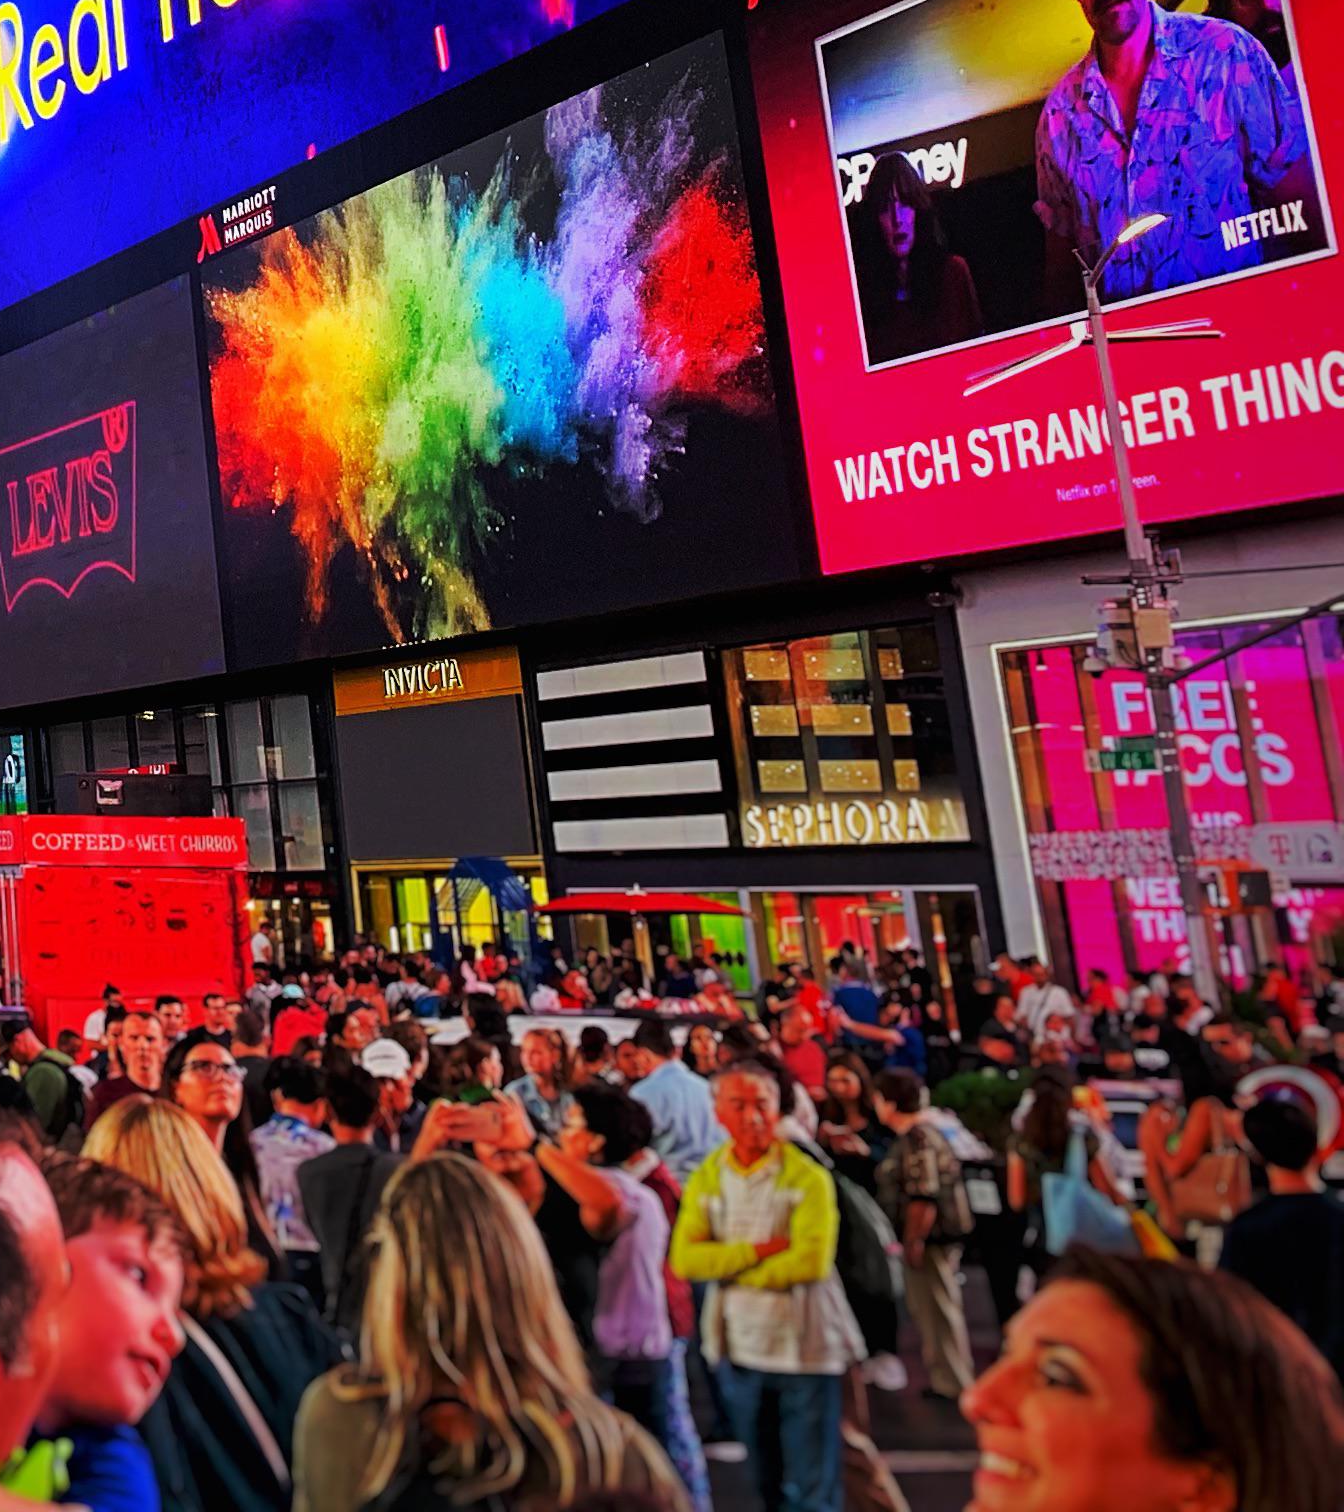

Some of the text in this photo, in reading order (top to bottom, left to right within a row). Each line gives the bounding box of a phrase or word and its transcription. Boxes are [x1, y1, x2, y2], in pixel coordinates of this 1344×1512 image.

[222, 186, 276, 224] MARRIOTT
[224, 210, 272, 244] MARQUIS
[1220, 199, 1308, 252] NETFLIX
[834, 434, 961, 504] WATCH
[1056, 483, 1092, 504] Netflix
[381, 656, 465, 699] INVICTA
[32, 831, 239, 853] COFFEED SWEET CHURROS
[746, 797, 931, 847] SEPHORA
